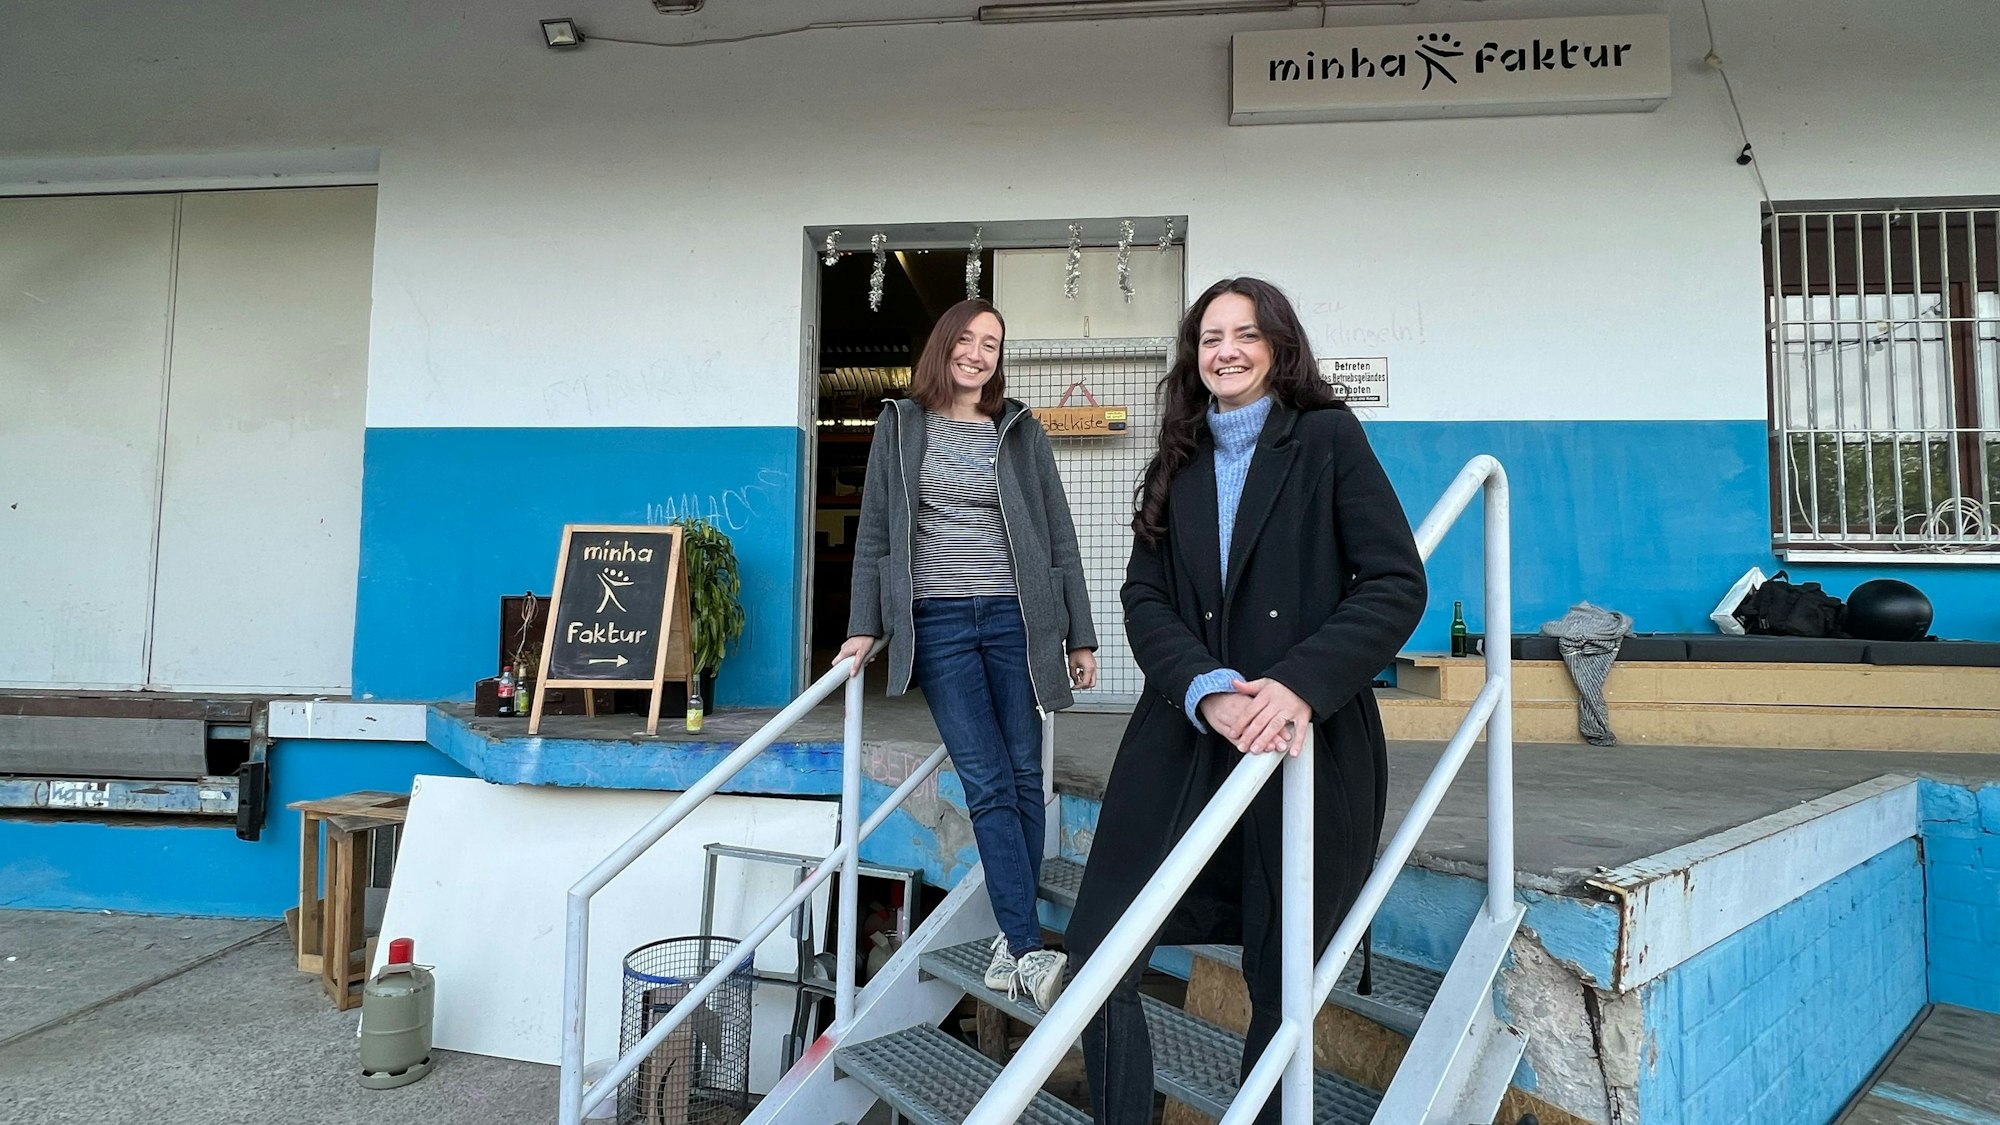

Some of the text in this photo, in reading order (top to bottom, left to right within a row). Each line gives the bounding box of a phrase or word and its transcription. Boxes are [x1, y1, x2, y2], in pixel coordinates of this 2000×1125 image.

[1269, 39, 1632, 81] minha Faktur
[1334, 361, 1371, 371] Betreten
[1332, 372, 1386, 384] Betriebsgeländes
[583, 540, 654, 562] minha
[567, 621, 648, 644] Faktur
